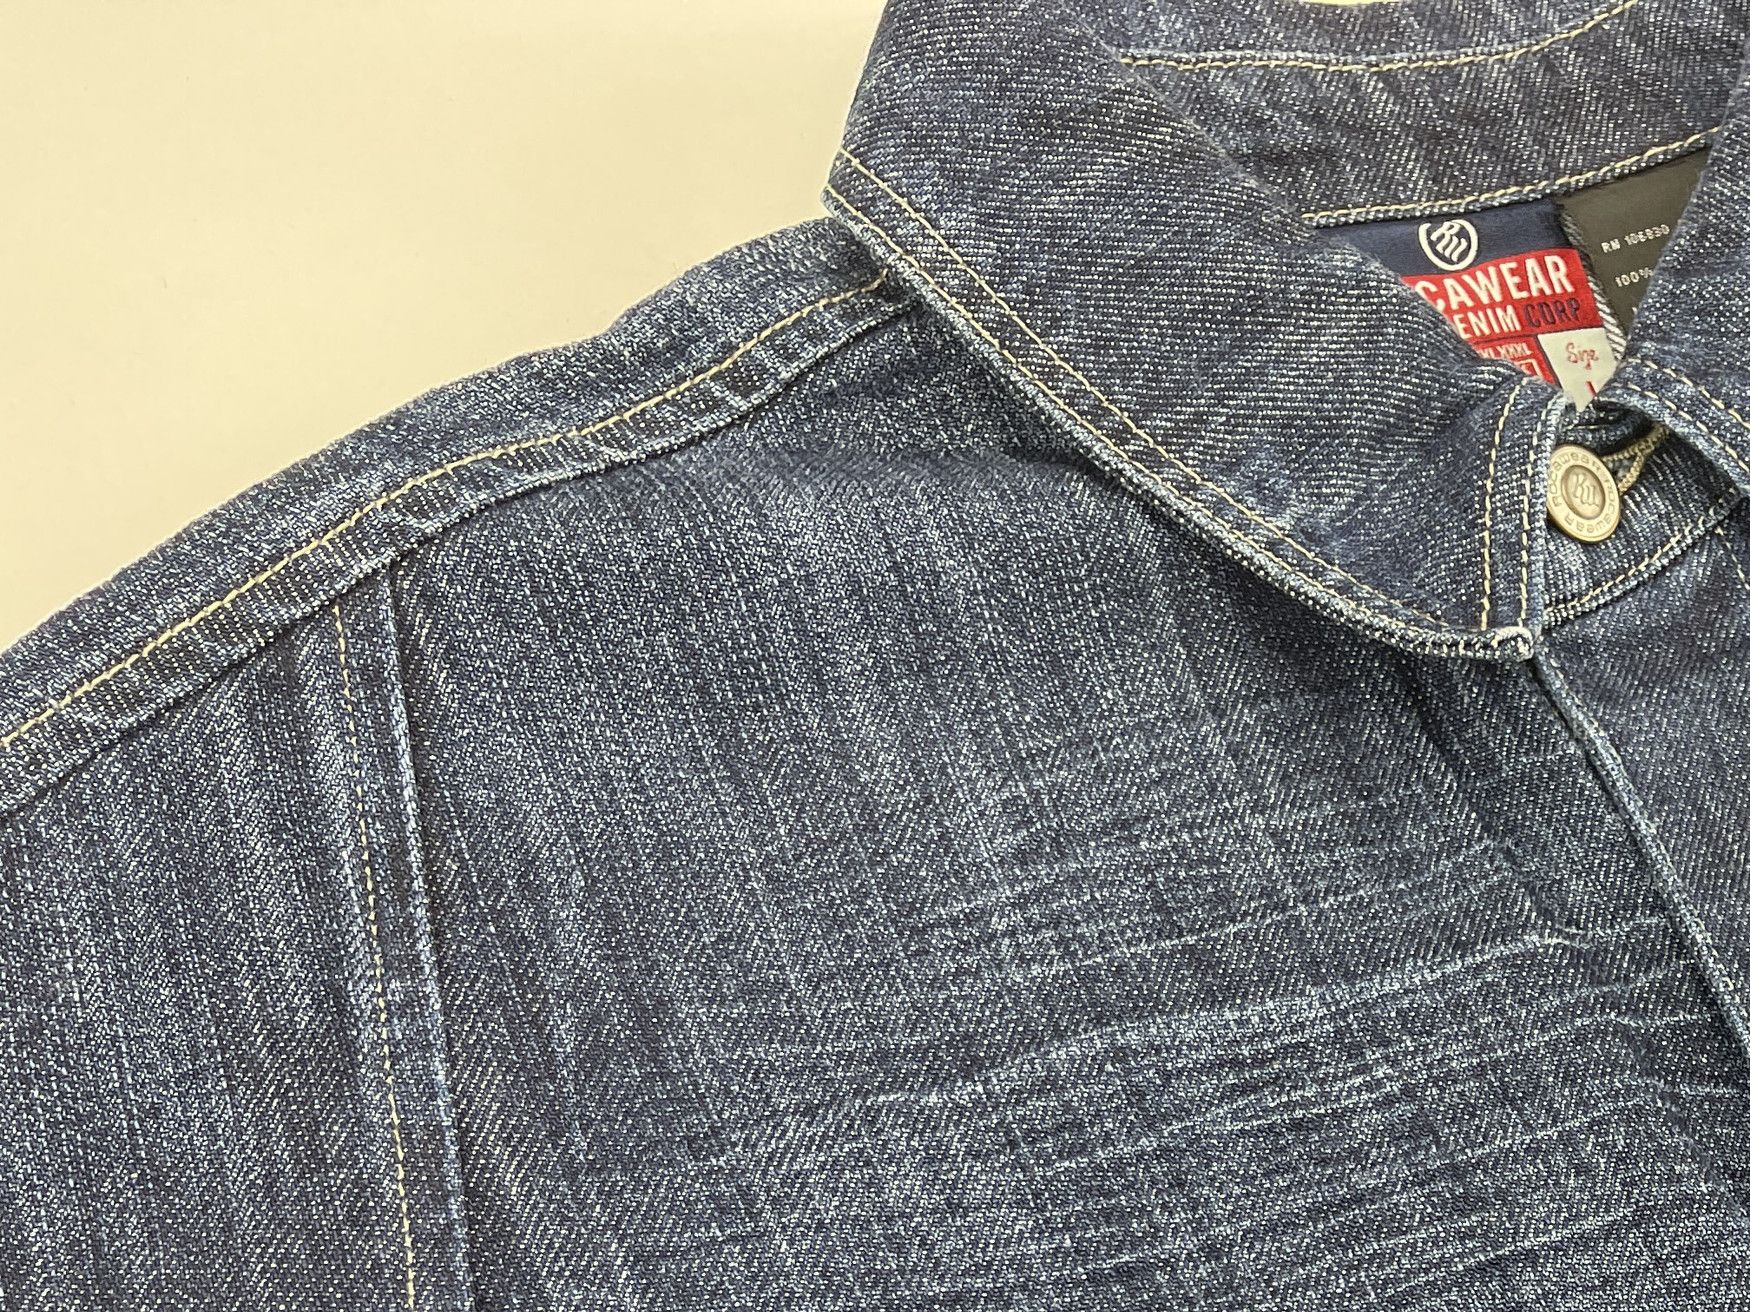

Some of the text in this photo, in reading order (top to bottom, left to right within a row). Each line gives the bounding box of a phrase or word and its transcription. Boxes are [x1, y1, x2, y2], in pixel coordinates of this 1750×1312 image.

[1601, 238, 1620, 253] RN
[1414, 254, 1576, 313] CAWEAR
[1614, 267, 1654, 287] 100%
[1453, 297, 1581, 340] ENIM CORP
